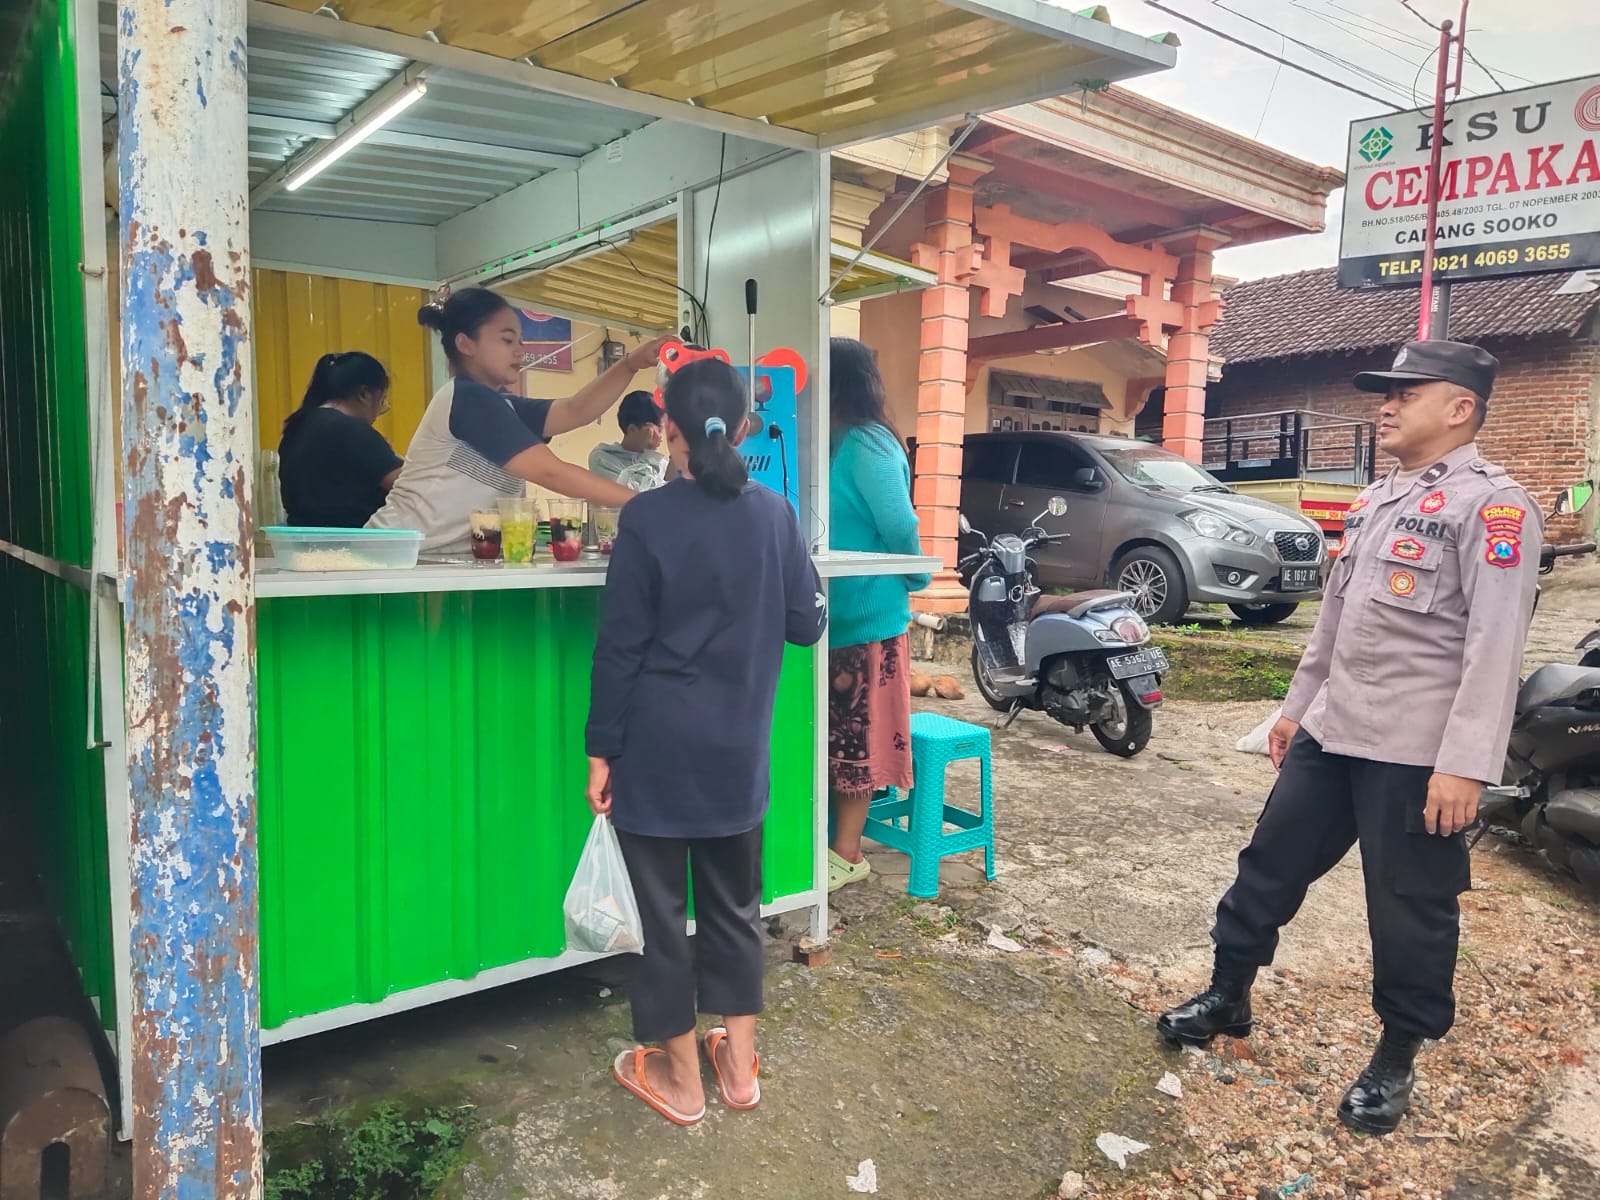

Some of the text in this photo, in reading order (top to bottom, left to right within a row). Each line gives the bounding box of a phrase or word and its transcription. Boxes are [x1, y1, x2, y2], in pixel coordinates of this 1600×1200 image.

[1416, 101, 1552, 151] KSU
[1364, 139, 1600, 211] CEMPAKA
[1509, 200, 1520, 210] 07
[1522, 193, 1578, 208] NOPEMBER
[1483, 213, 1558, 235] SOOKO
[1379, 258, 1422, 276] TELP.
[1474, 248, 1519, 267] 4069
[1524, 243, 1571, 262] 3655
[1395, 516, 1447, 538] POLRI
[1110, 658, 1122, 671] AE
[1124, 654, 1147, 665] 5362
